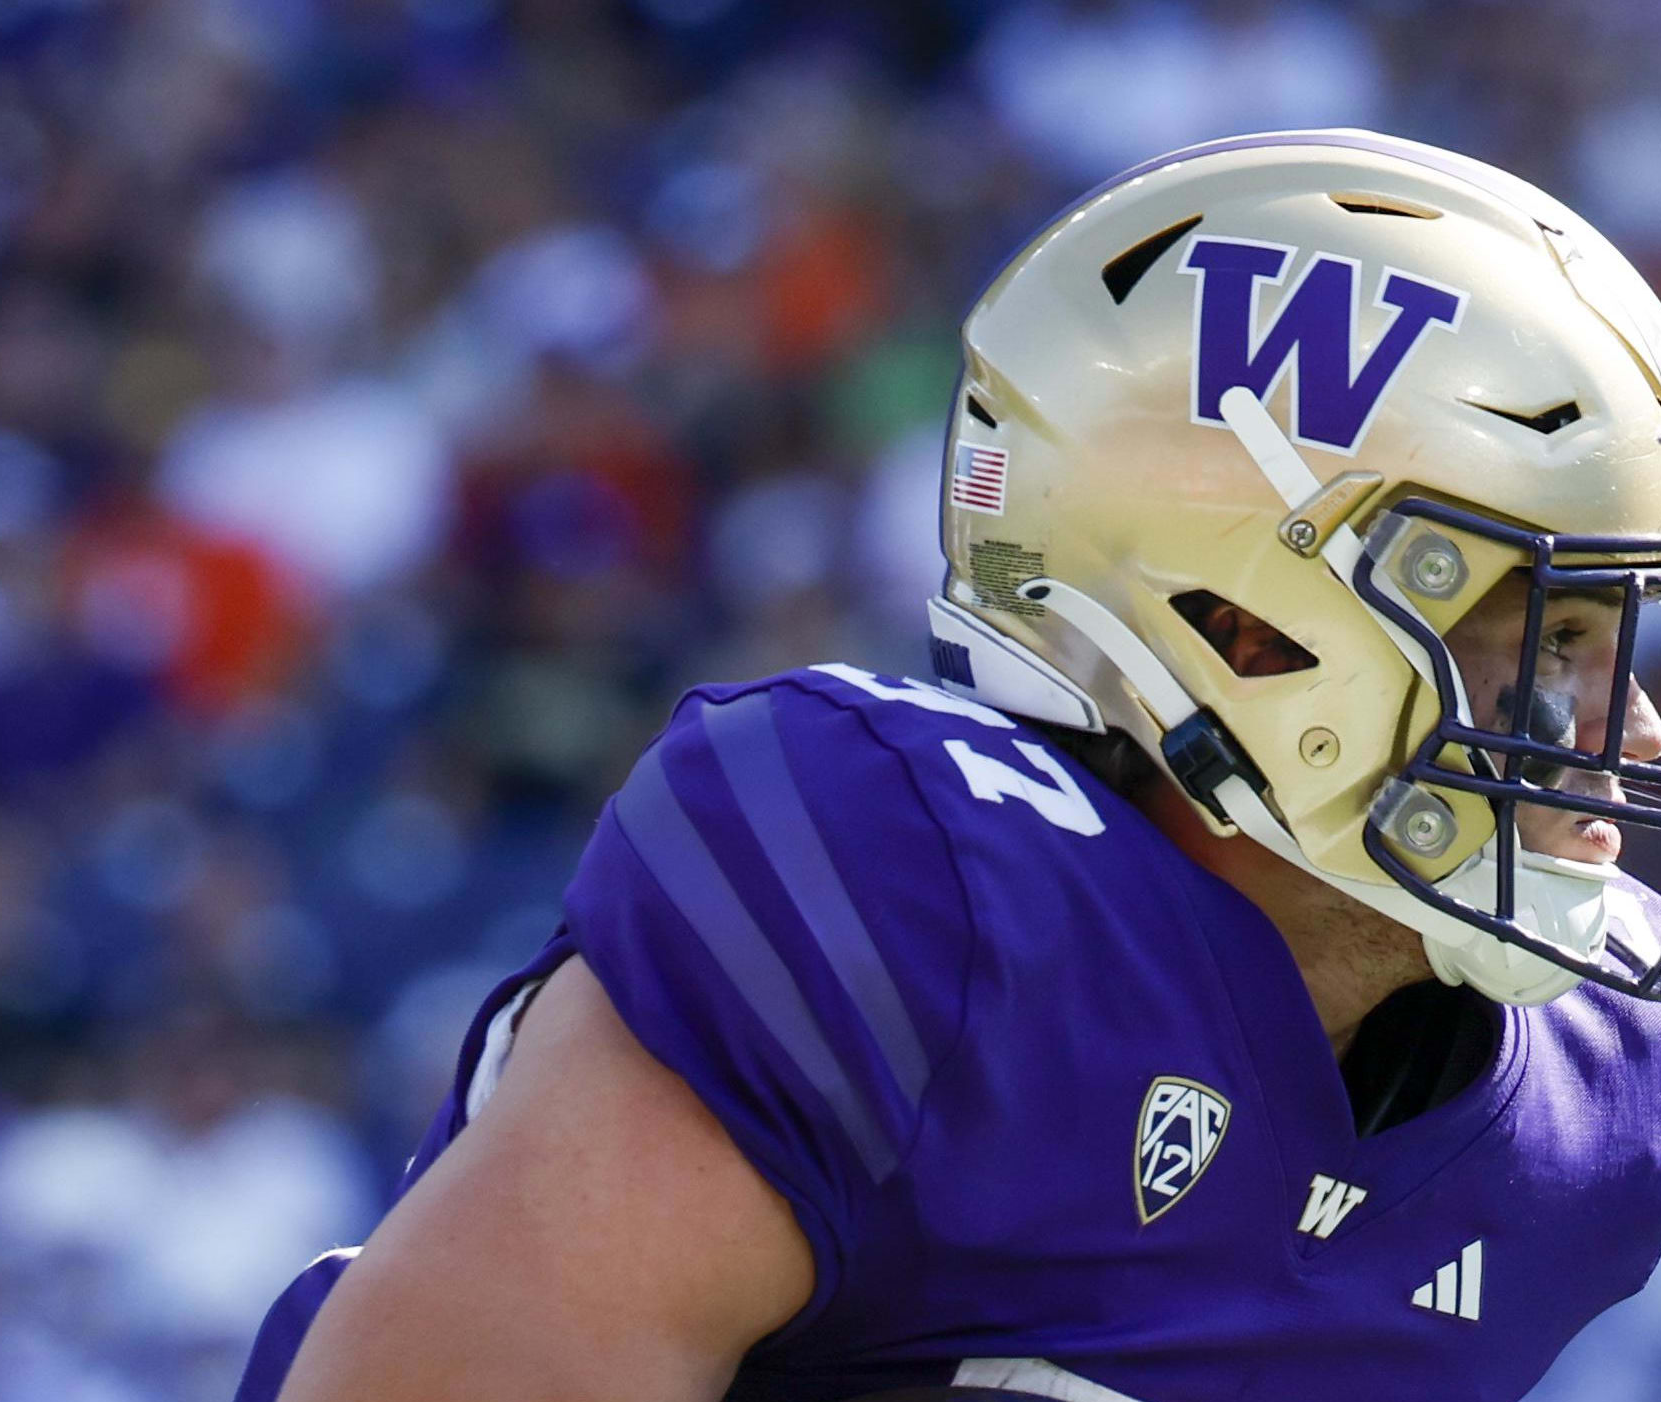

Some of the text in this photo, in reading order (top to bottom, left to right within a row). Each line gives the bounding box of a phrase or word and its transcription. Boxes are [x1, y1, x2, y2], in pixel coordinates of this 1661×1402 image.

[1177, 236, 1468, 455] W
[1141, 1084, 1227, 1177] PAC
[1142, 1140, 1191, 1196] 12
[1297, 1174, 1367, 1239] W
